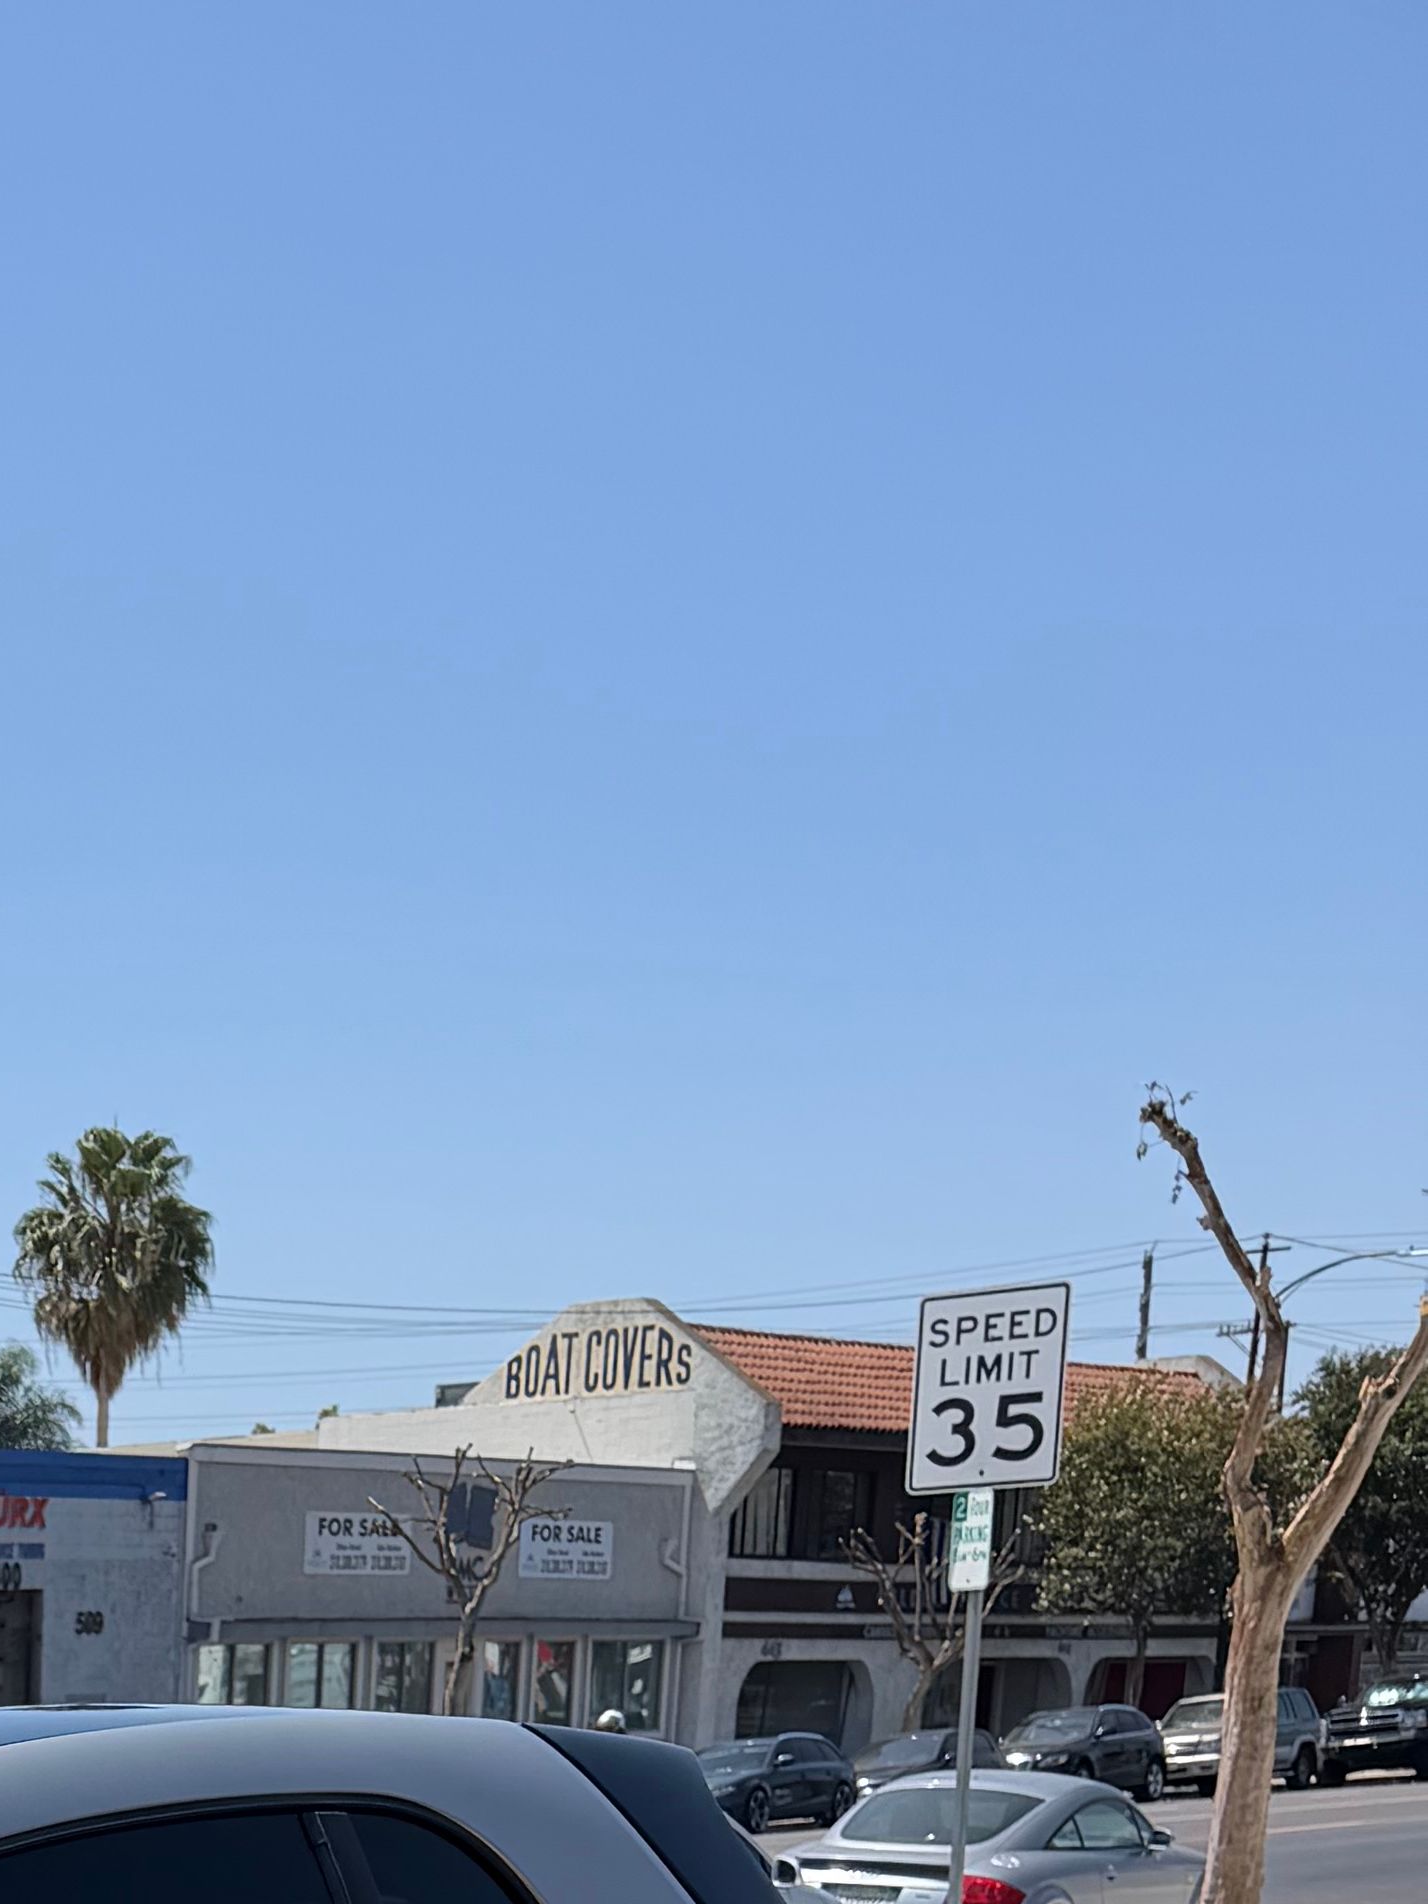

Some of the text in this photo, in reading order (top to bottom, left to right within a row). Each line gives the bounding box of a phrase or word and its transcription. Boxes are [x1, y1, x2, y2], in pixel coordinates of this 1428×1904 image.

[929, 1307, 1058, 1348] SPEED
[505, 1324, 692, 1399] BOAT COVERS
[939, 1349, 1040, 1387] LIMIT
[925, 1391, 1044, 1467] 35
[955, 1496, 966, 1519] 2
[318, 1517, 354, 1537] FOR
[531, 1524, 603, 1545] FOR SALE
